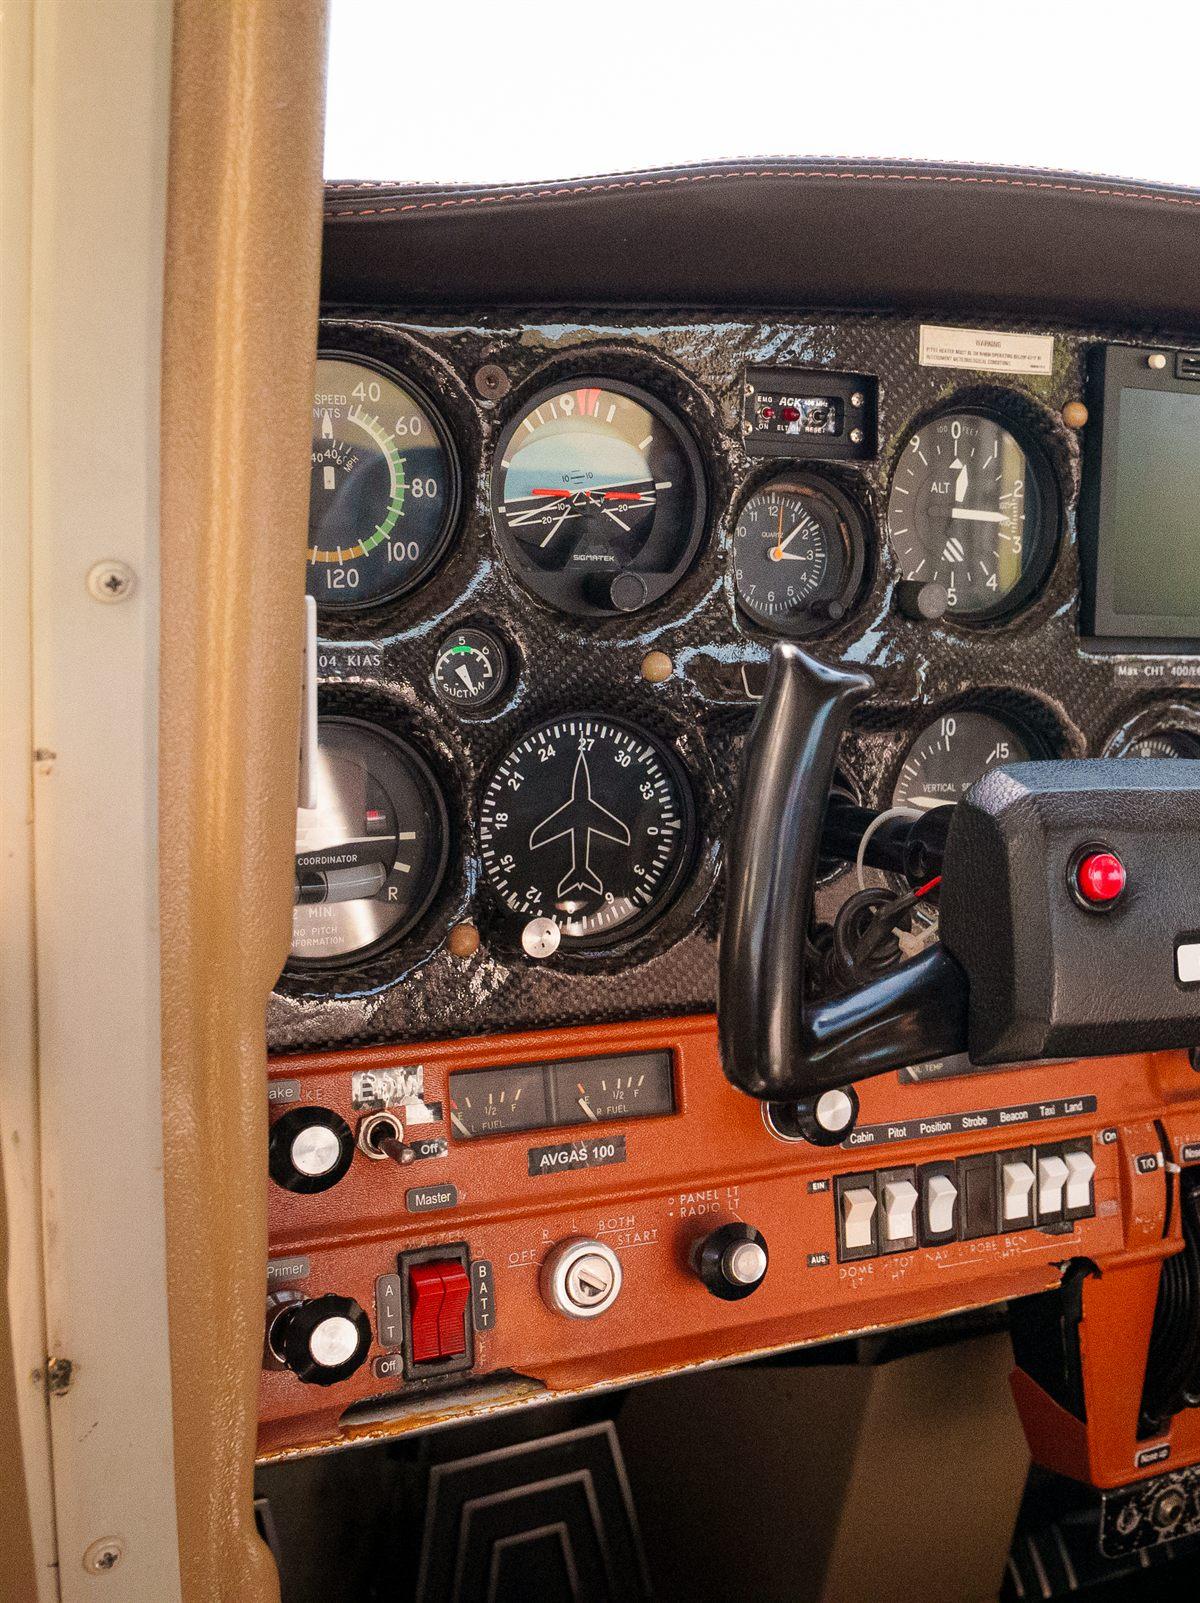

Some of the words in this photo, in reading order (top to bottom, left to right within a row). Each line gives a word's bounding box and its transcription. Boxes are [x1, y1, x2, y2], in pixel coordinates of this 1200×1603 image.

[352, 380, 380, 402] 40
[314, 394, 347, 406] SPEED
[778, 396, 802, 407] ACK
[312, 408, 341, 419] NOTS
[396, 416, 422, 436] 60
[759, 423, 769, 431] ON
[951, 421, 961, 439] 0
[909, 434, 920, 453] 9
[344, 455, 360, 473] MPH
[562, 474, 570, 483] 10
[584, 472, 594, 480] 10
[411, 478, 438, 498] 80
[930, 482, 951, 494] ALT
[1013, 480, 1024, 497] 2
[618, 504, 628, 512] 20
[768, 505, 779, 517] 12
[542, 516, 552, 524] 20
[749, 511, 758, 522] 11
[790, 513, 795, 523] 1
[736, 526, 747, 538] 10
[802, 529, 809, 540] 2
[1012, 536, 1022, 554] 3
[387, 541, 420, 562] 100
[806, 550, 814, 561] 3
[326, 568, 360, 589] 120
[736, 570, 743, 580] 8
[800, 572, 808, 581] 4
[985, 574, 998, 591] 4
[750, 584, 756, 595] 7
[787, 586, 794, 596] 5
[768, 591, 775, 602] 6
[947, 588, 957, 606] 5
[458, 636, 466, 645] 5
[482, 645, 490, 655] 6
[319, 655, 336, 668] 04
[347, 654, 380, 667] KIAS
[443, 681, 485, 698] SUCTION
[940, 718, 956, 737] 10
[577, 738, 595, 751] 27
[996, 742, 1010, 759] 15
[537, 744, 556, 763] 24
[614, 750, 631, 768] 30
[507, 771, 525, 791] 21
[639, 781, 654, 800] 33
[922, 783, 956, 792] VERTICAL
[494, 812, 509, 830] 18
[298, 854, 358, 866] COORDINATOR
[500, 854, 516, 873] 15
[633, 864, 645, 876] 3
[388, 886, 398, 900] R
[525, 886, 542, 904] 12
[293, 929, 305, 937] NO
[311, 926, 338, 935] PITCH
[291, 936, 345, 948] NFORMATION
[925, 1063, 944, 1072] TEMP
[268, 1087, 294, 1100] ake
[612, 1090, 624, 1100] 1/2
[634, 1089, 640, 1098] F
[485, 1106, 497, 1116] 1/2
[511, 1103, 517, 1112] F
[606, 1104, 629, 1114] FUEL
[482, 1120, 506, 1130] FUEL
[850, 1132, 874, 1145] Cabin
[888, 1126, 907, 1138] Pitot
[919, 1121, 952, 1134] Position
[961, 1116, 988, 1128] Strobe
[999, 1110, 1029, 1123] Beacon
[1040, 1104, 1056, 1116] Taxi
[1064, 1100, 1083, 1114] Land
[1104, 1132, 1117, 1140] On
[420, 1143, 439, 1155] Off
[540, 1149, 588, 1168] AVGAS
[592, 1144, 616, 1159] 100
[812, 1182, 825, 1191] EIN
[415, 1191, 451, 1206] Master
[680, 1189, 719, 1205] PANEL
[726, 1186, 740, 1199] LT
[680, 1202, 720, 1218] RADIO
[728, 1198, 740, 1211] LT
[572, 1220, 577, 1229] L
[598, 1215, 636, 1231] BOTH
[542, 1230, 550, 1240] R
[618, 1229, 658, 1246] START
[509, 1250, 537, 1263] OFF
[810, 1255, 826, 1264] AUS
[266, 1264, 304, 1278] Primer
[478, 1265, 489, 1326] BATT
[385, 1284, 396, 1338] ALT
[380, 1360, 396, 1373] Off
